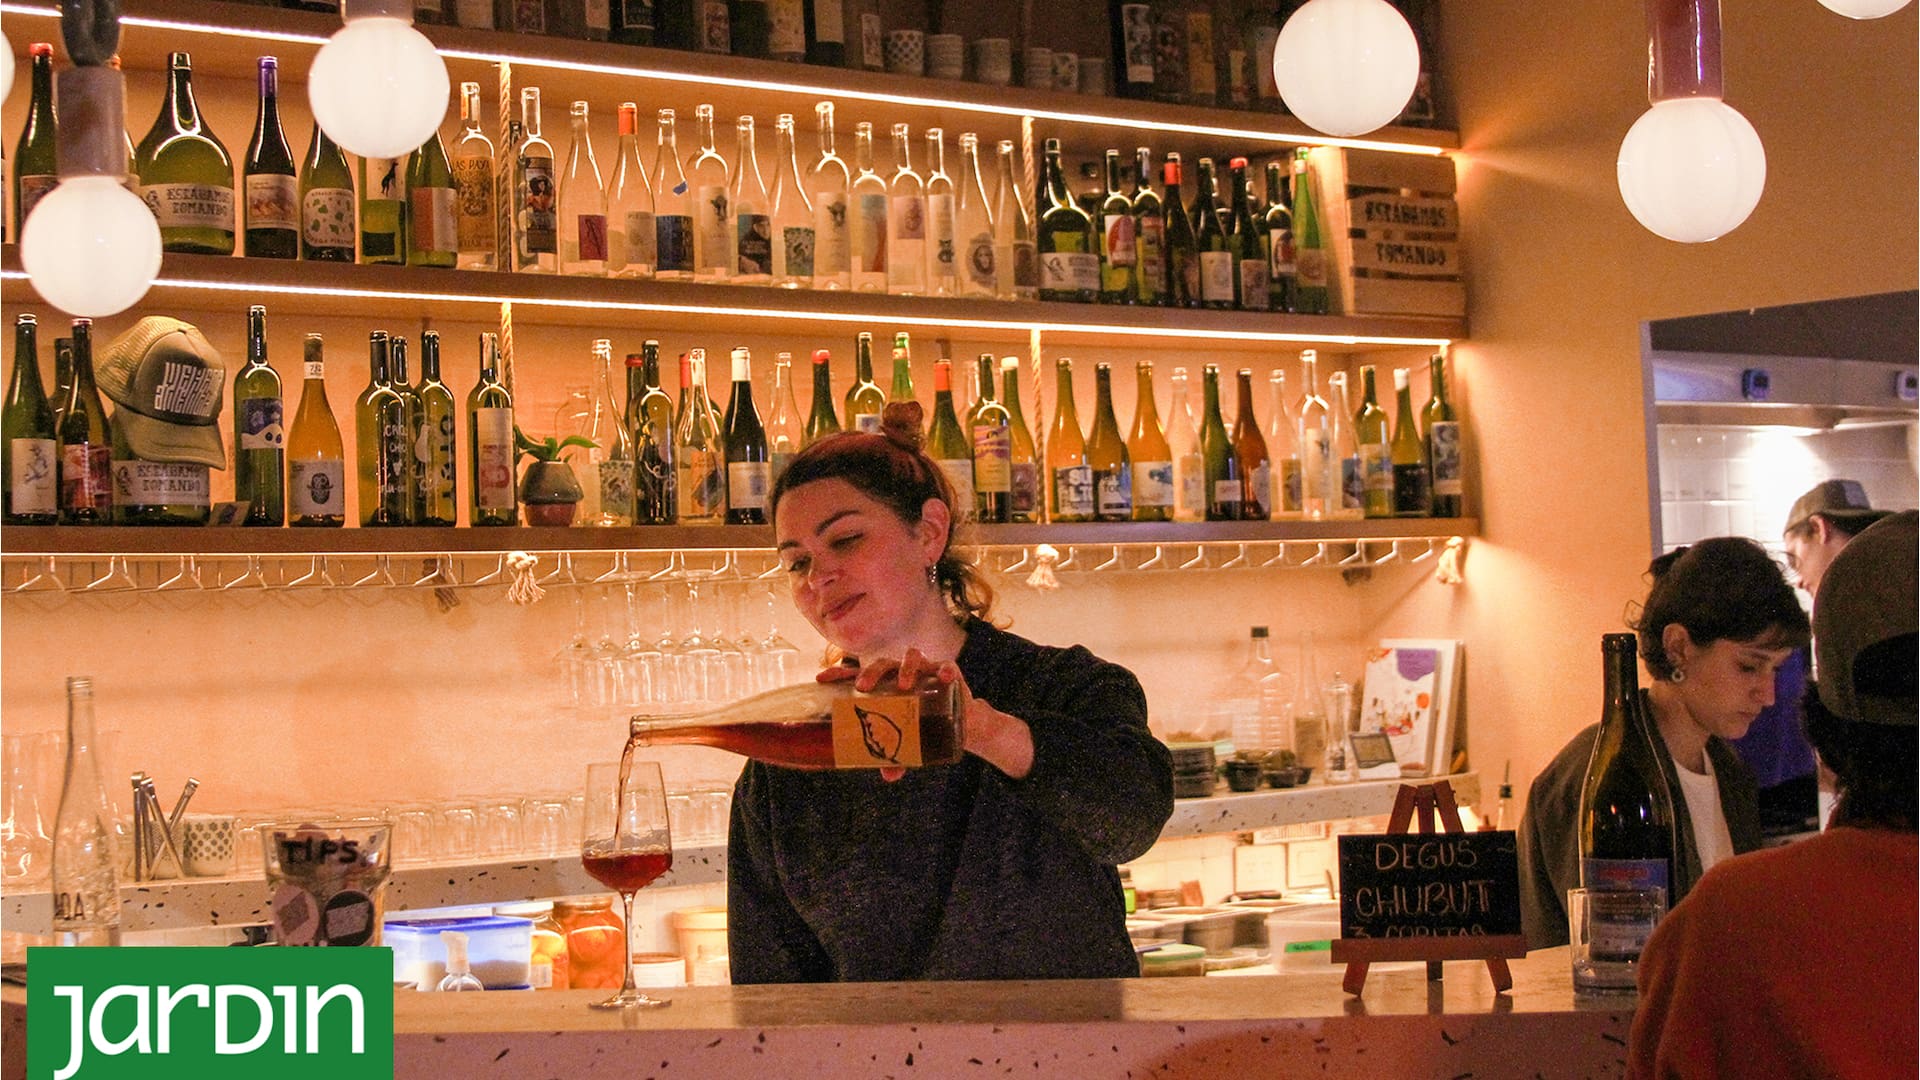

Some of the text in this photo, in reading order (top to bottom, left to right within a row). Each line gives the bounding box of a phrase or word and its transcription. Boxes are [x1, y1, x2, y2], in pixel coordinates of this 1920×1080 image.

[1376, 242, 1446, 266] TOMANDO
[282, 837, 359, 865] TIPS
[1375, 839, 1477, 871] DEGUS
[1356, 879, 1495, 918] CHUBUT
